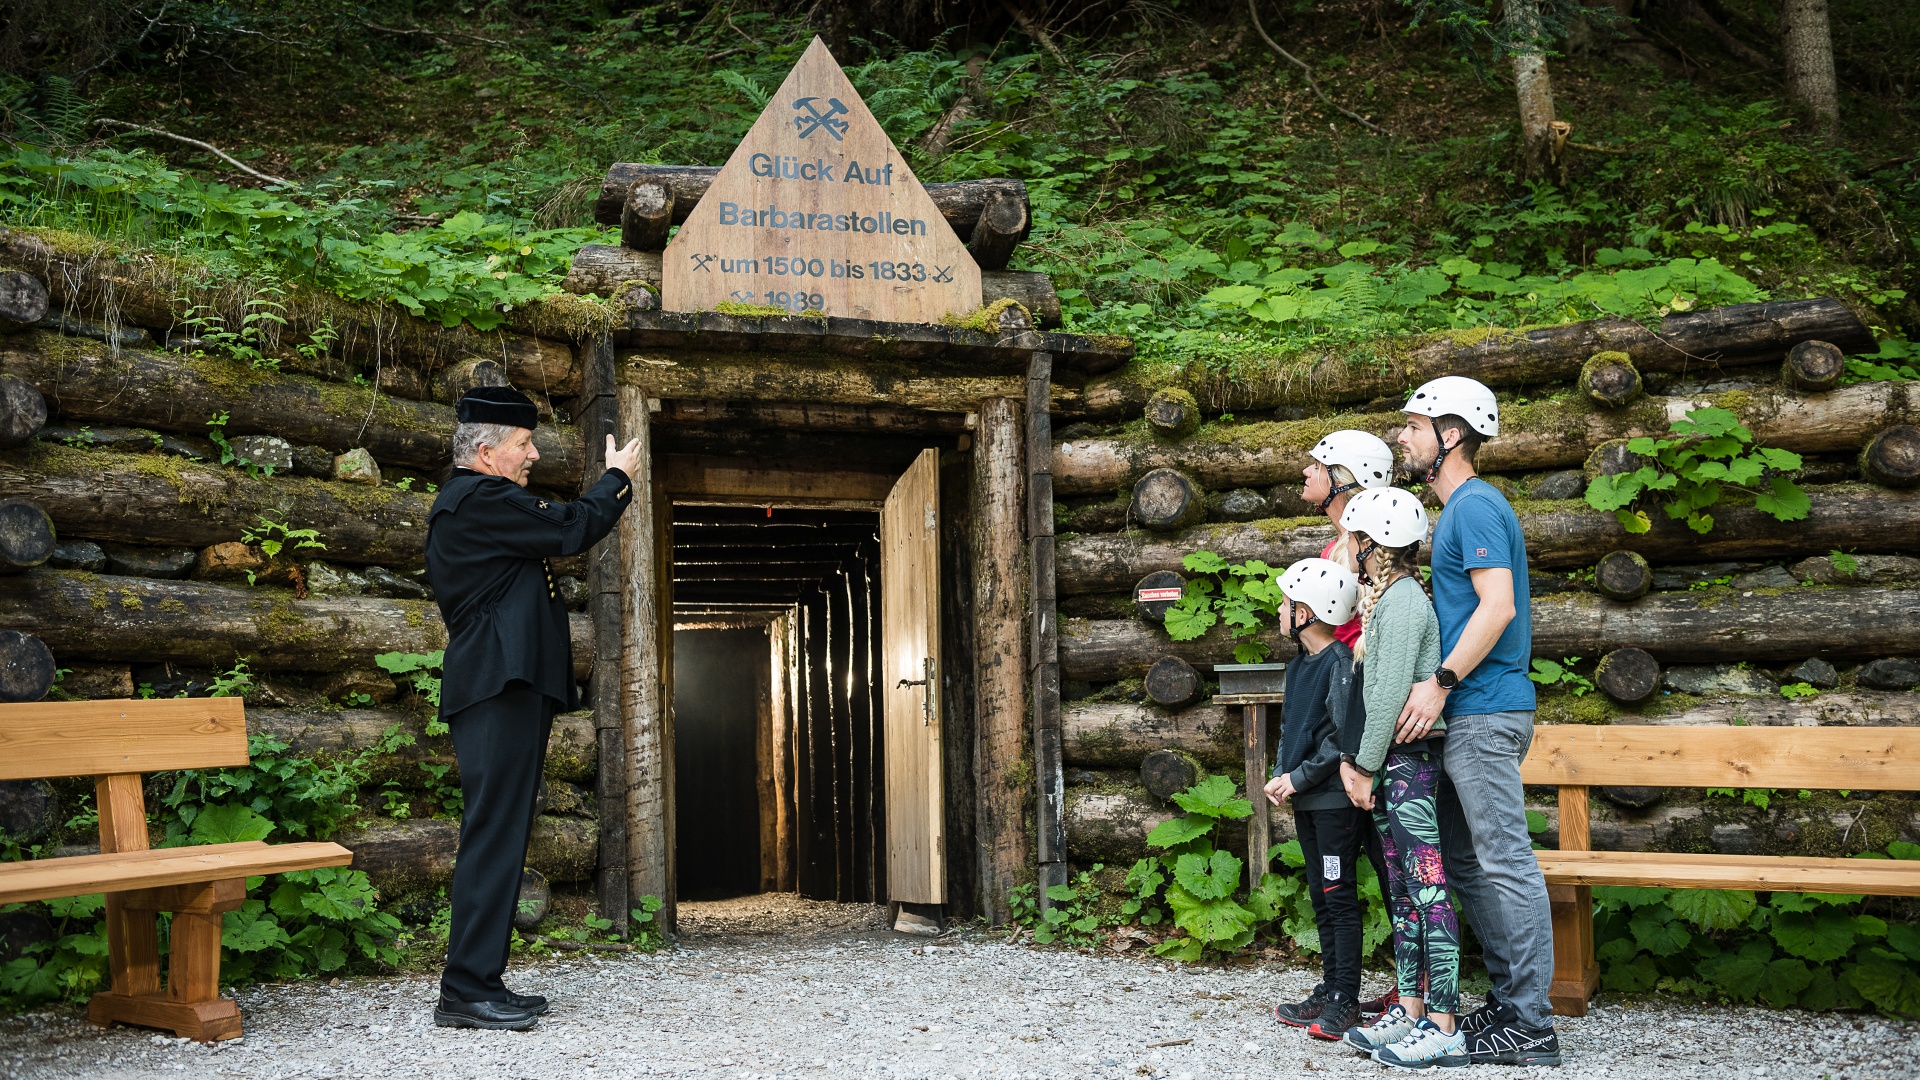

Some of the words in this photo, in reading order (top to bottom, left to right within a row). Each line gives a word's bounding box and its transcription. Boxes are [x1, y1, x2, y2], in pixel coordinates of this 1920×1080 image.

[749, 153, 834, 183] Glück
[843, 160, 893, 186] Auf
[719, 202, 927, 236] Barbarastollen
[720, 258, 759, 274] um
[763, 256, 825, 278] 1500
[830, 259, 865, 279] bis
[868, 261, 927, 283] 1833
[764, 290, 825, 312] 1989
